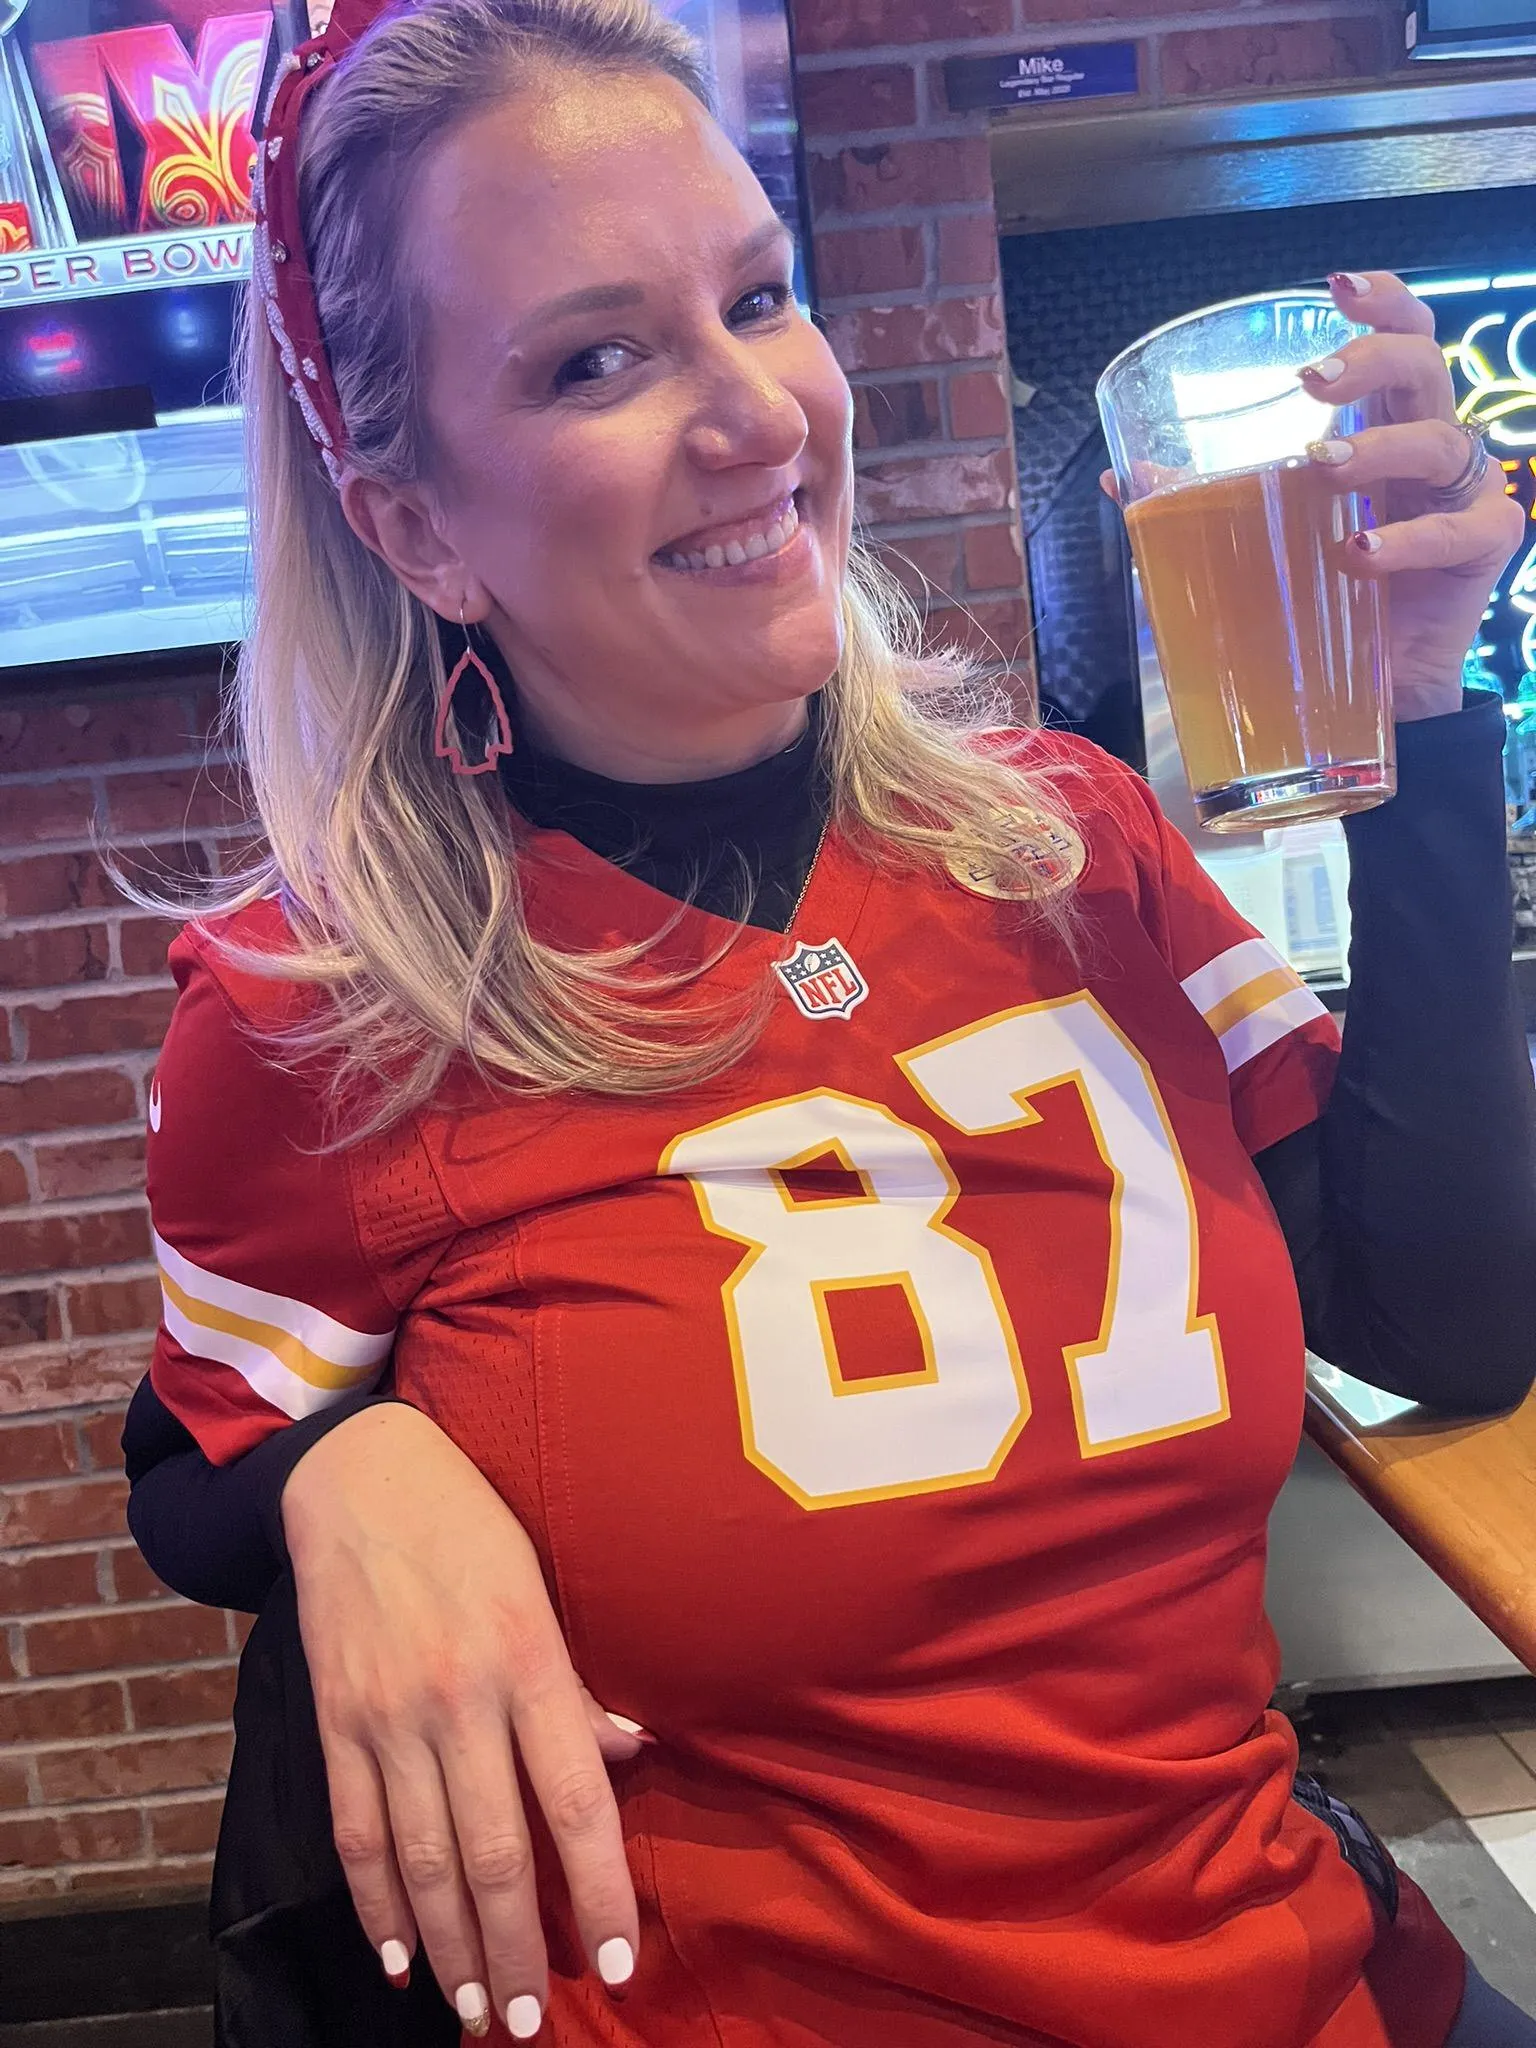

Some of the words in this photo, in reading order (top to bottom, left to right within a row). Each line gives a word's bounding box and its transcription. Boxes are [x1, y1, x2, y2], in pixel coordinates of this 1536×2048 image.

[1018, 56, 1065, 75] Mike
[798, 967, 858, 1009] NFL
[658, 987, 1232, 1512] 87
